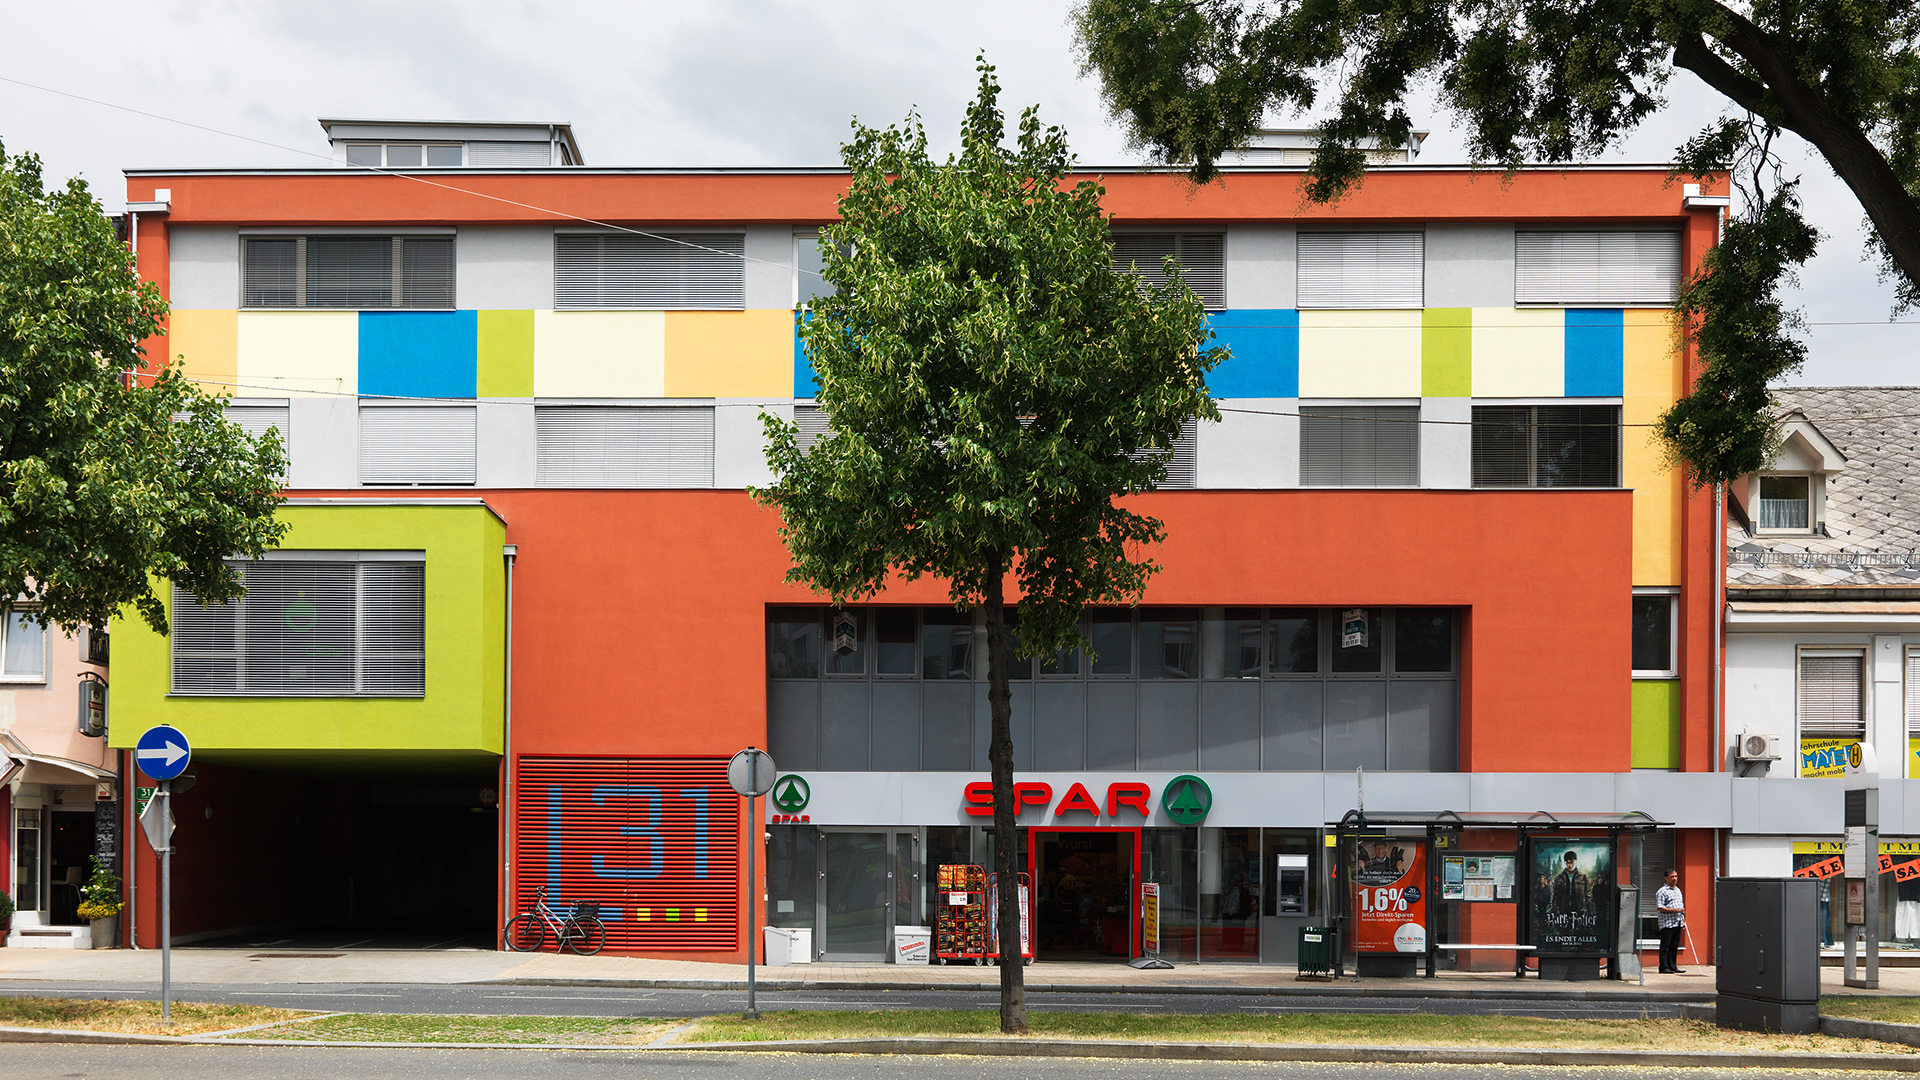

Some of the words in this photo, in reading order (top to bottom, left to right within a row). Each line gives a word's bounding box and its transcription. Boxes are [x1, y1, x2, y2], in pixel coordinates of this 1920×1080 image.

[1801, 740, 1839, 755] Fahrschule
[141, 788, 151, 796] 31
[964, 781, 1151, 817] SPAR
[773, 814, 810, 823] SPAR
[1058, 838, 1094, 850] Wurst
[1896, 865, 1920, 879] SA
[1359, 888, 1408, 913] 1,6%
[1376, 911, 1414, 919] Direkt-Sparen
